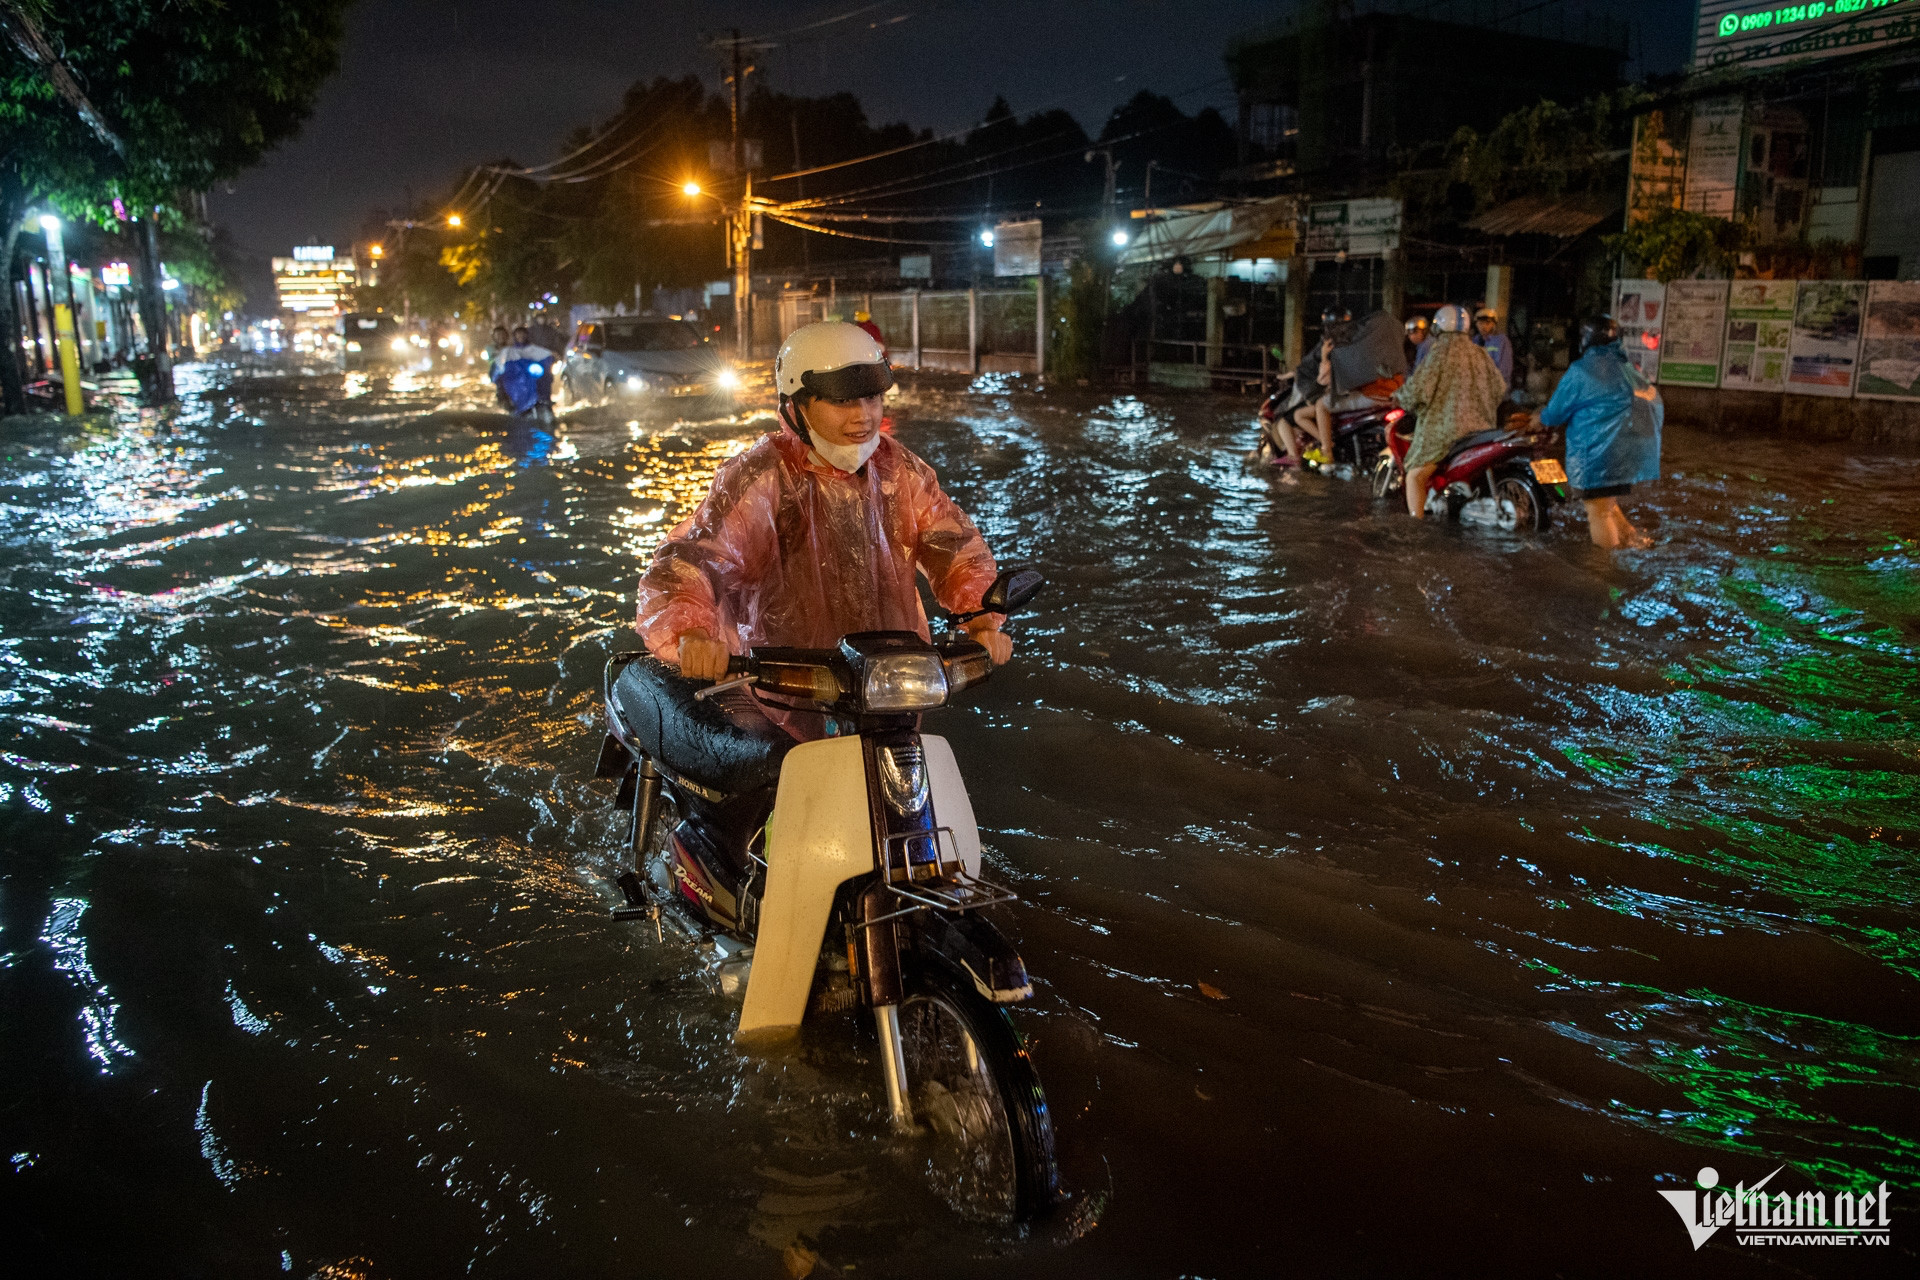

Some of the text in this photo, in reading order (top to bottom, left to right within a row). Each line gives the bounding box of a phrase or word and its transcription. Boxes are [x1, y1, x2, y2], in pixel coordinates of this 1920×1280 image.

[1741, 11, 1773, 32] 0909
[1775, 5, 1806, 25] 1234
[1808, 2, 1826, 21] 09
[677, 776, 709, 798] HONDA
[674, 863, 713, 904] DREAM
